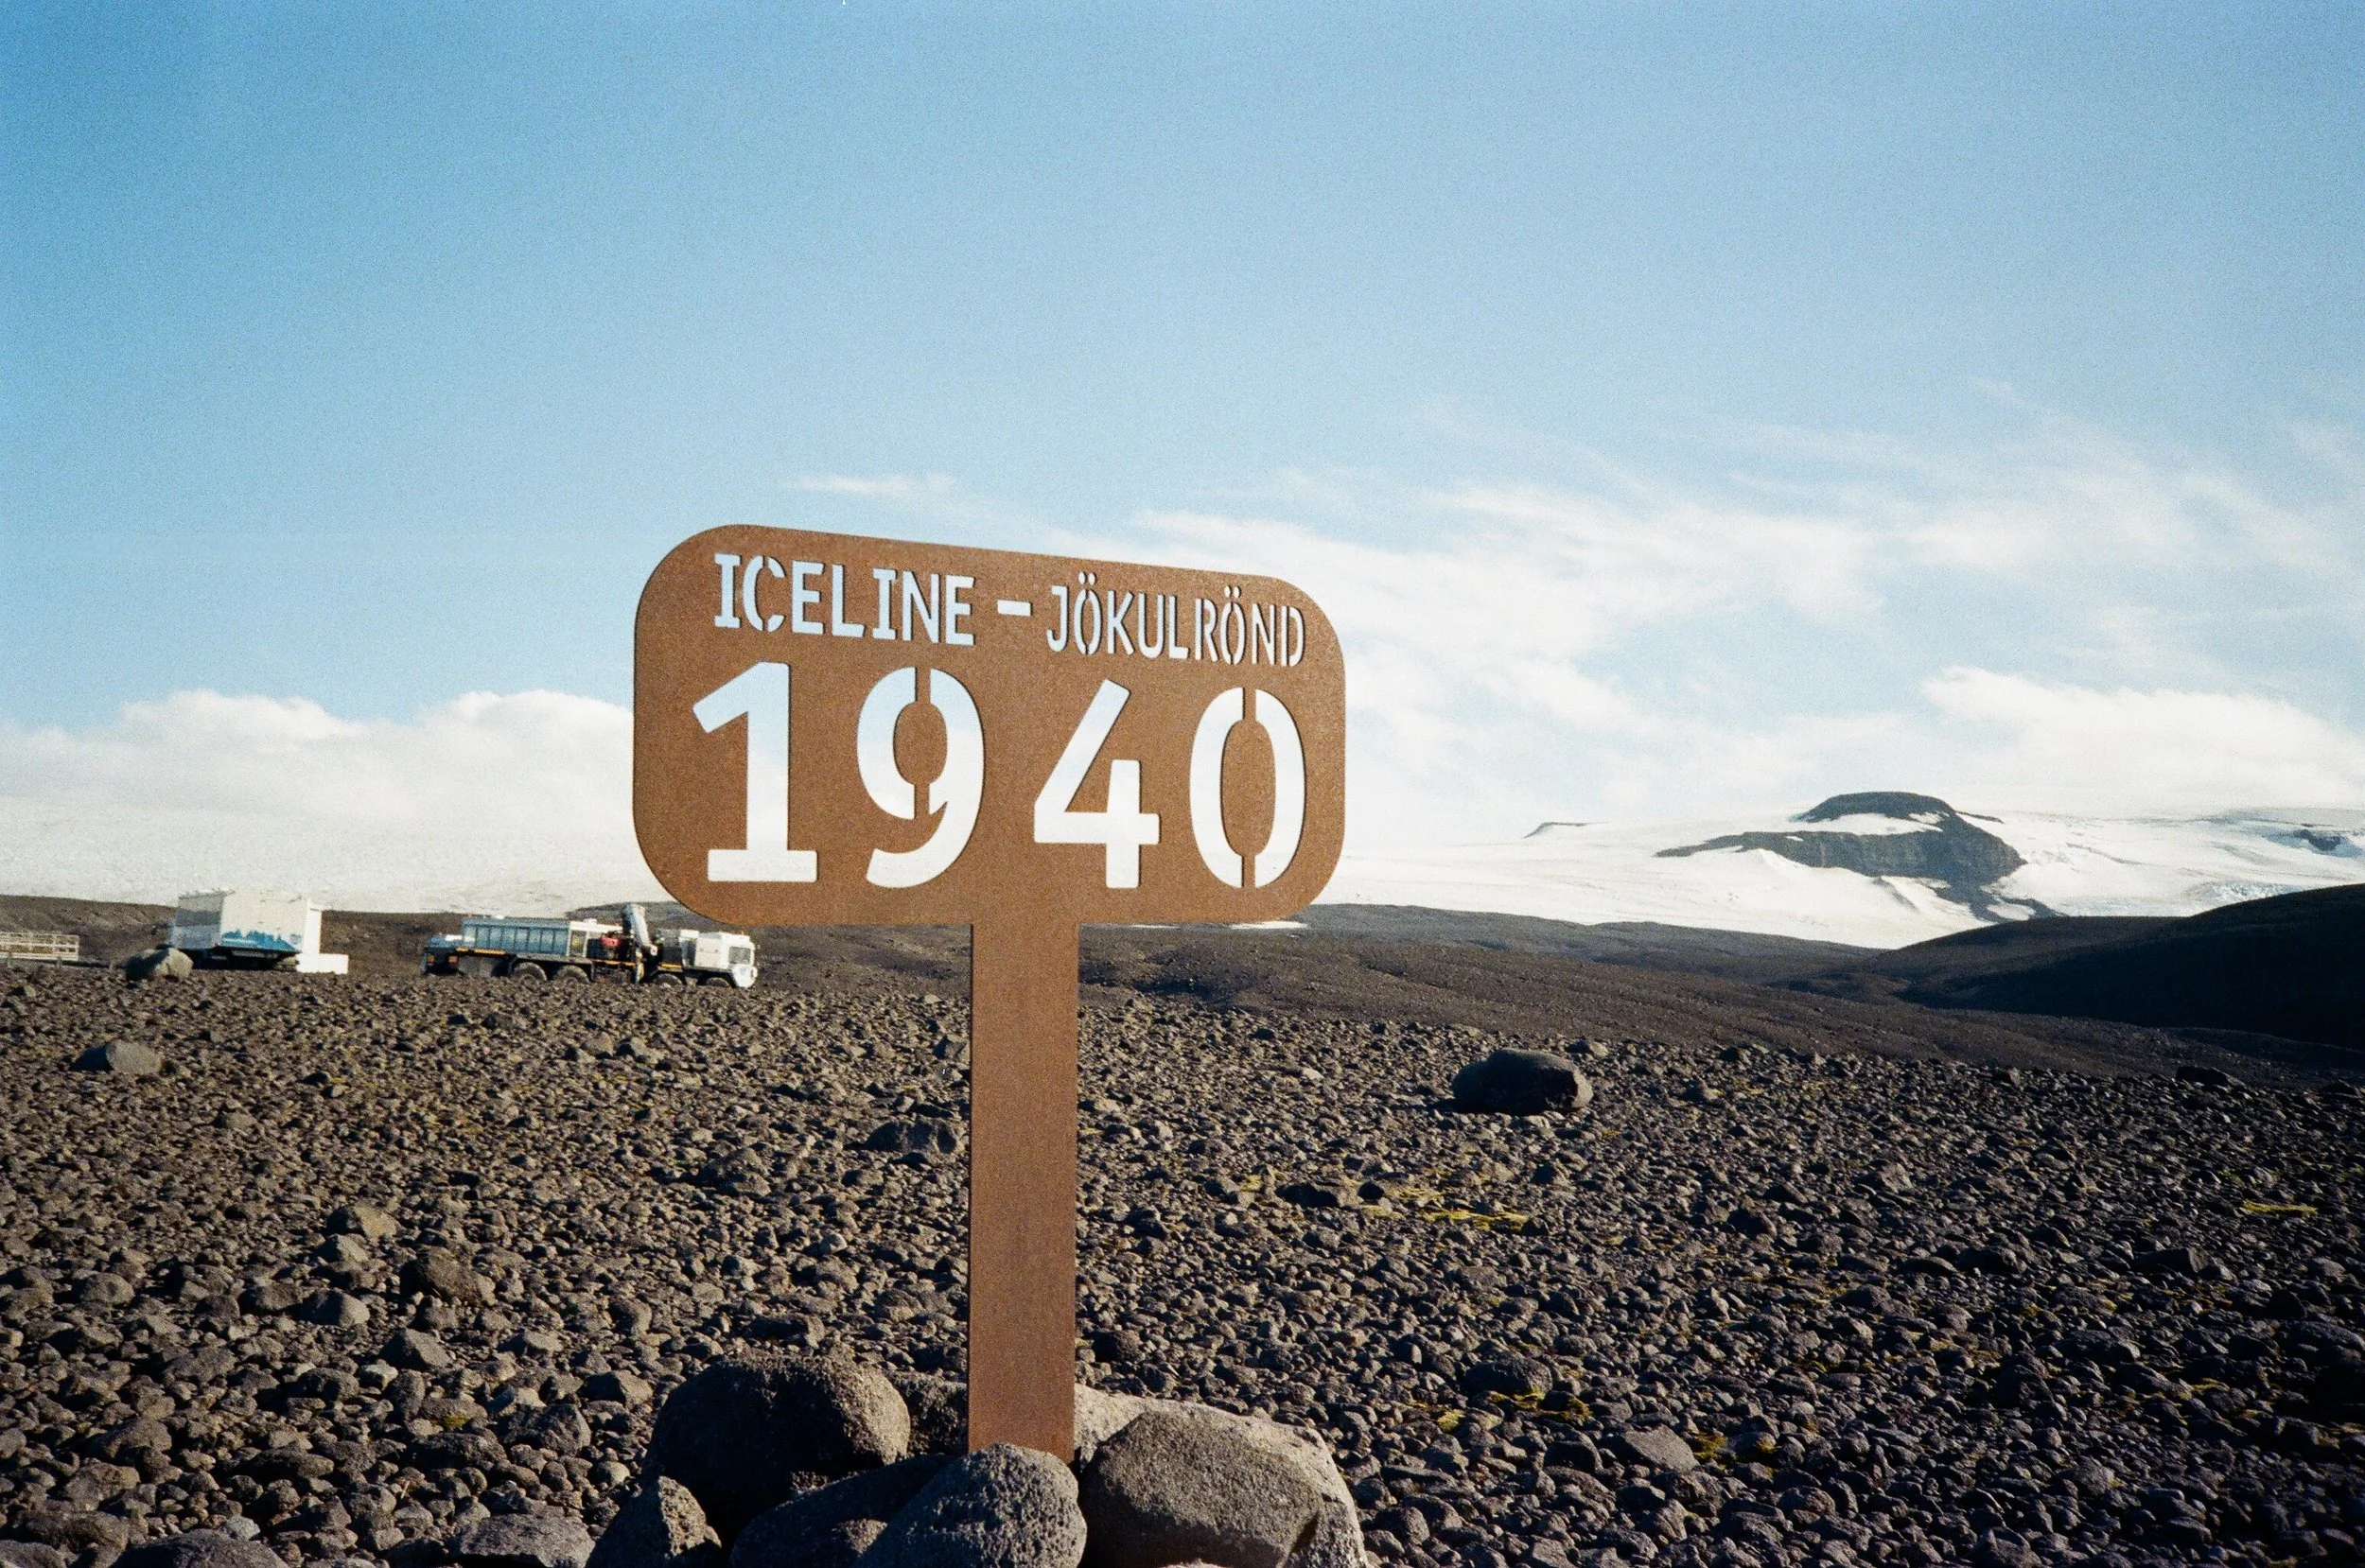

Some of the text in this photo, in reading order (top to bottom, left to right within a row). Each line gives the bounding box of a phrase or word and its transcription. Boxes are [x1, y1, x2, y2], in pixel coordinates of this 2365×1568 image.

[714, 552, 976, 646] ICELINE
[1045, 572, 1306, 668] JÖKULRÖND
[692, 661, 1306, 889] 1940
